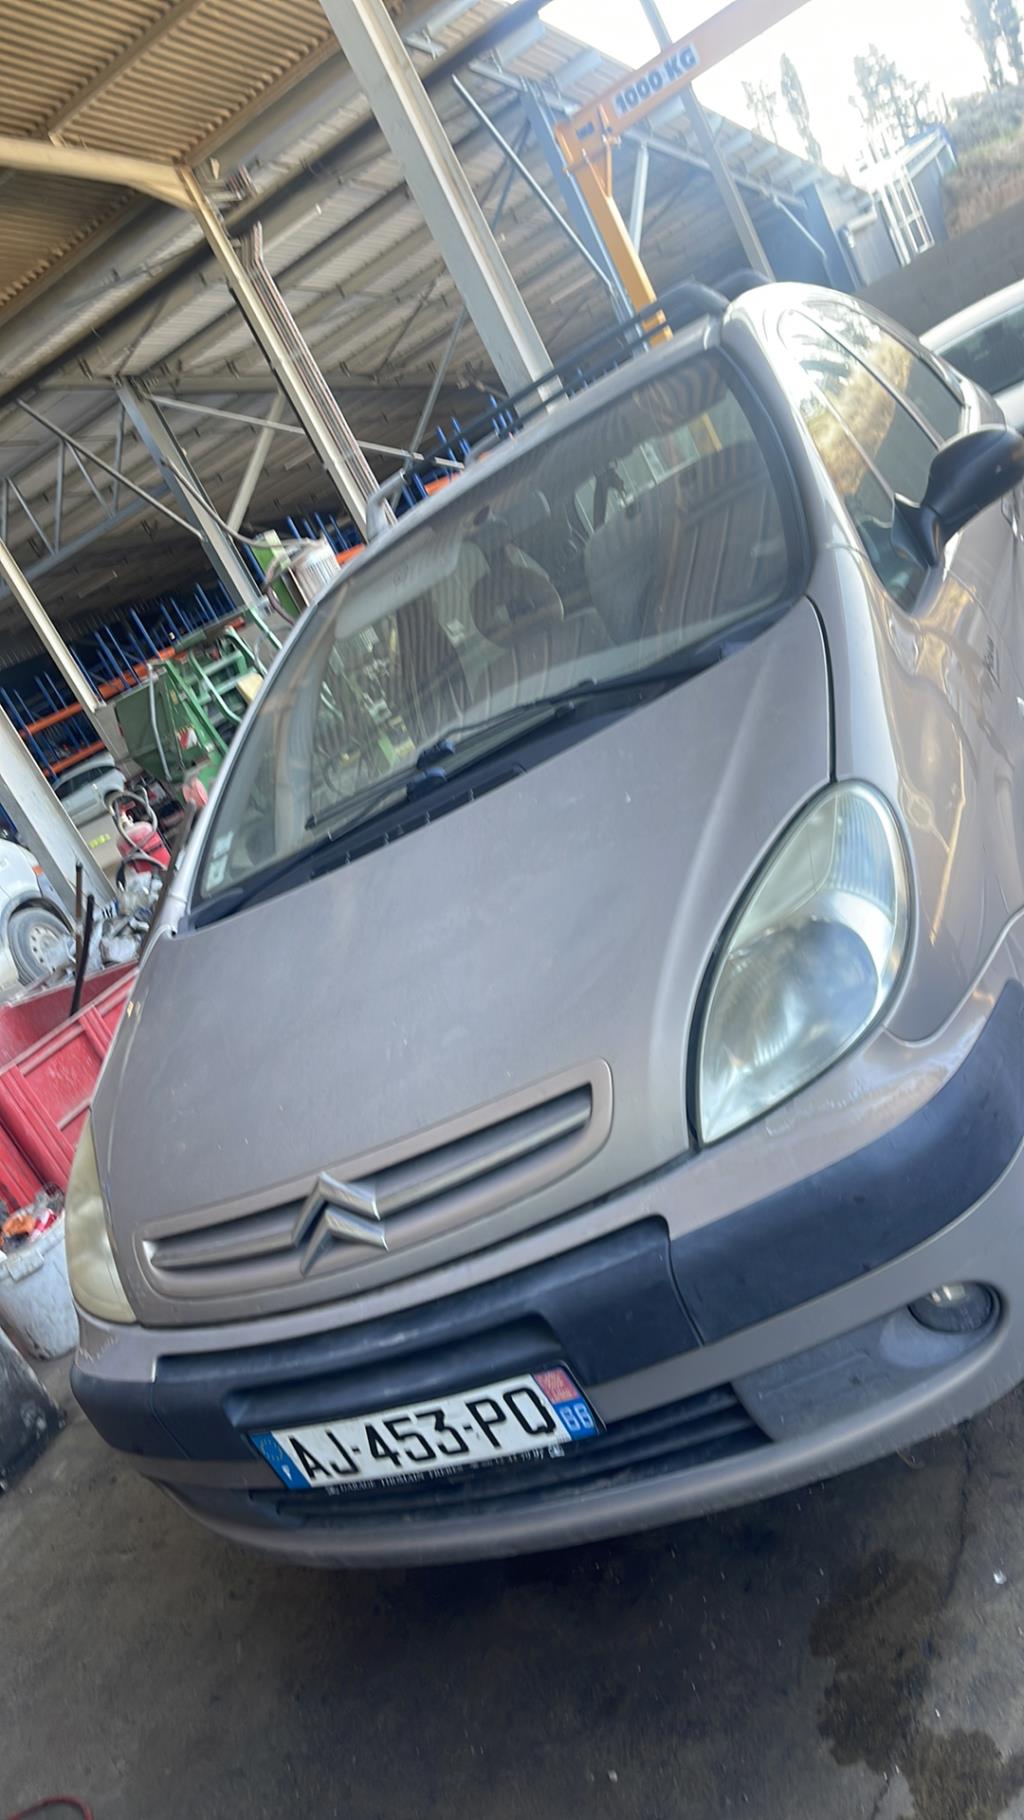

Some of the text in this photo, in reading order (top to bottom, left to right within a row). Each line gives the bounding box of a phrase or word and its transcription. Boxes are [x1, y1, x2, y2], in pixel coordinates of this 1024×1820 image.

[615, 47, 697, 113] 1000 KG
[288, 1387, 557, 1480] AJ-453-PQ
